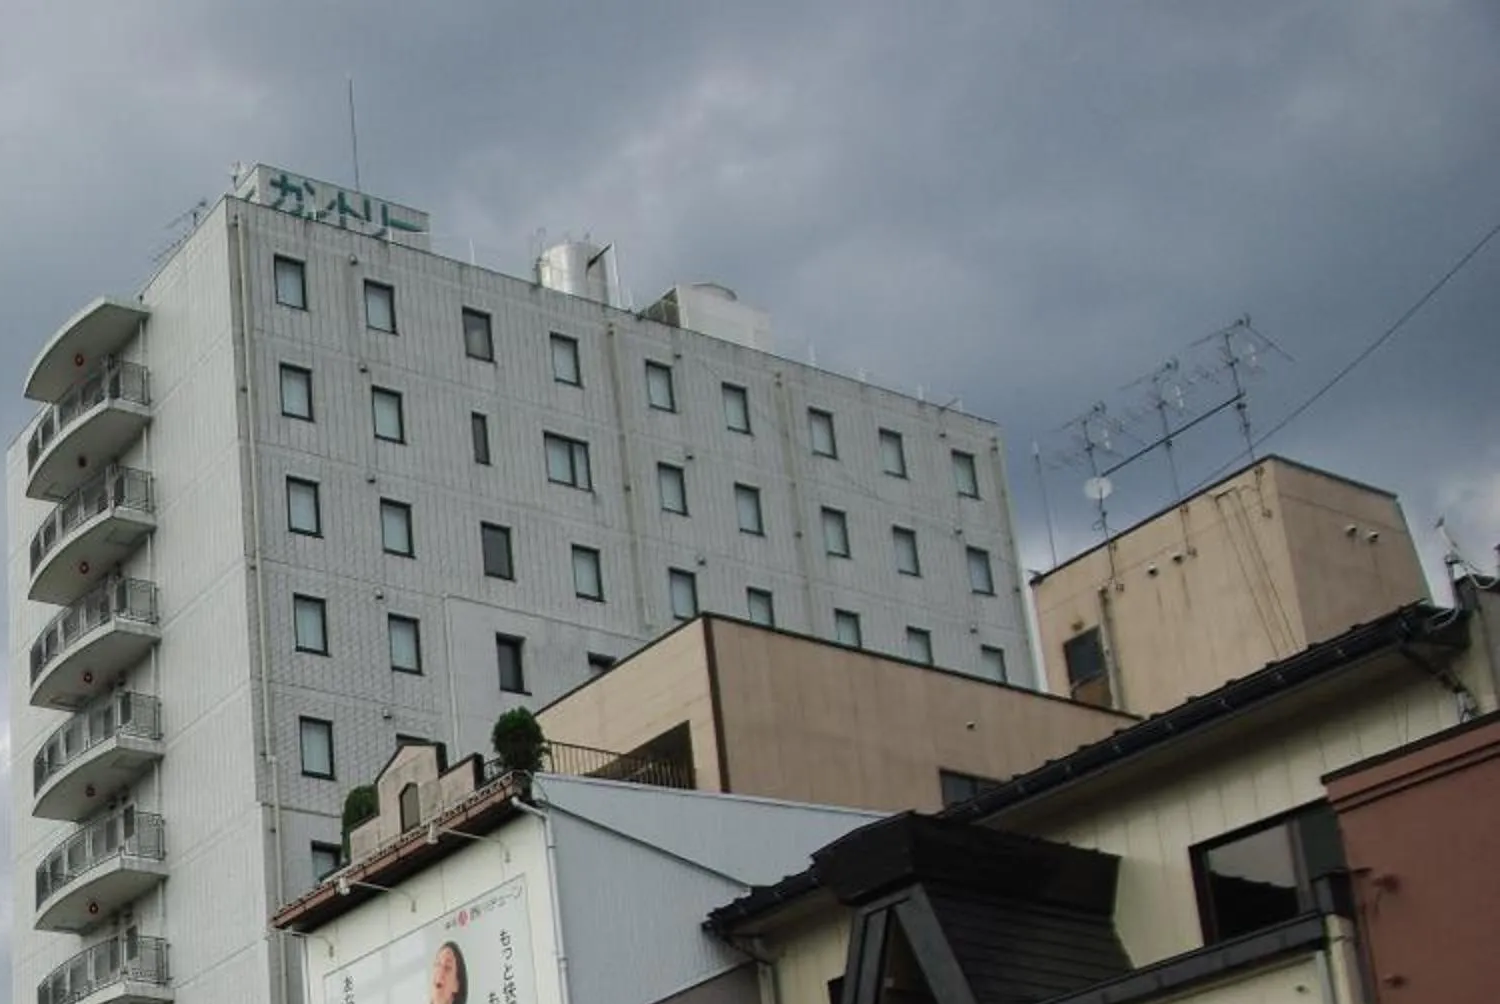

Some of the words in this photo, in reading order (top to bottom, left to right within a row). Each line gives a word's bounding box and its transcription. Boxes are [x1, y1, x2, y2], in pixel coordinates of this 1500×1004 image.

[269, 173, 423, 237] カントリー
